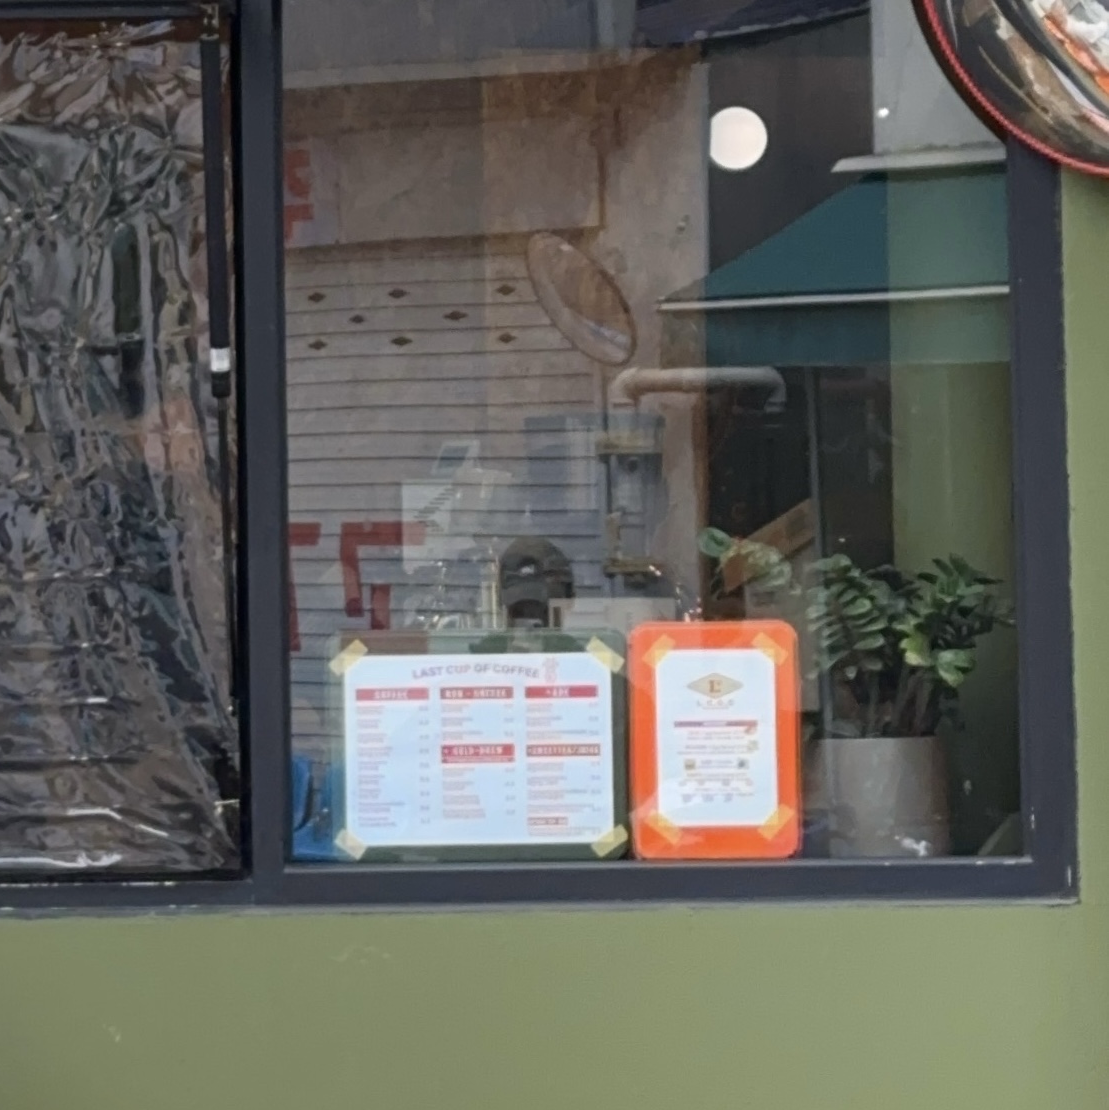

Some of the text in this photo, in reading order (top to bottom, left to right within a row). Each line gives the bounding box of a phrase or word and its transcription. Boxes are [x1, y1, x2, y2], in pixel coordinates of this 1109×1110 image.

[411, 662, 540, 680] LAST CUP OF COFFEE
